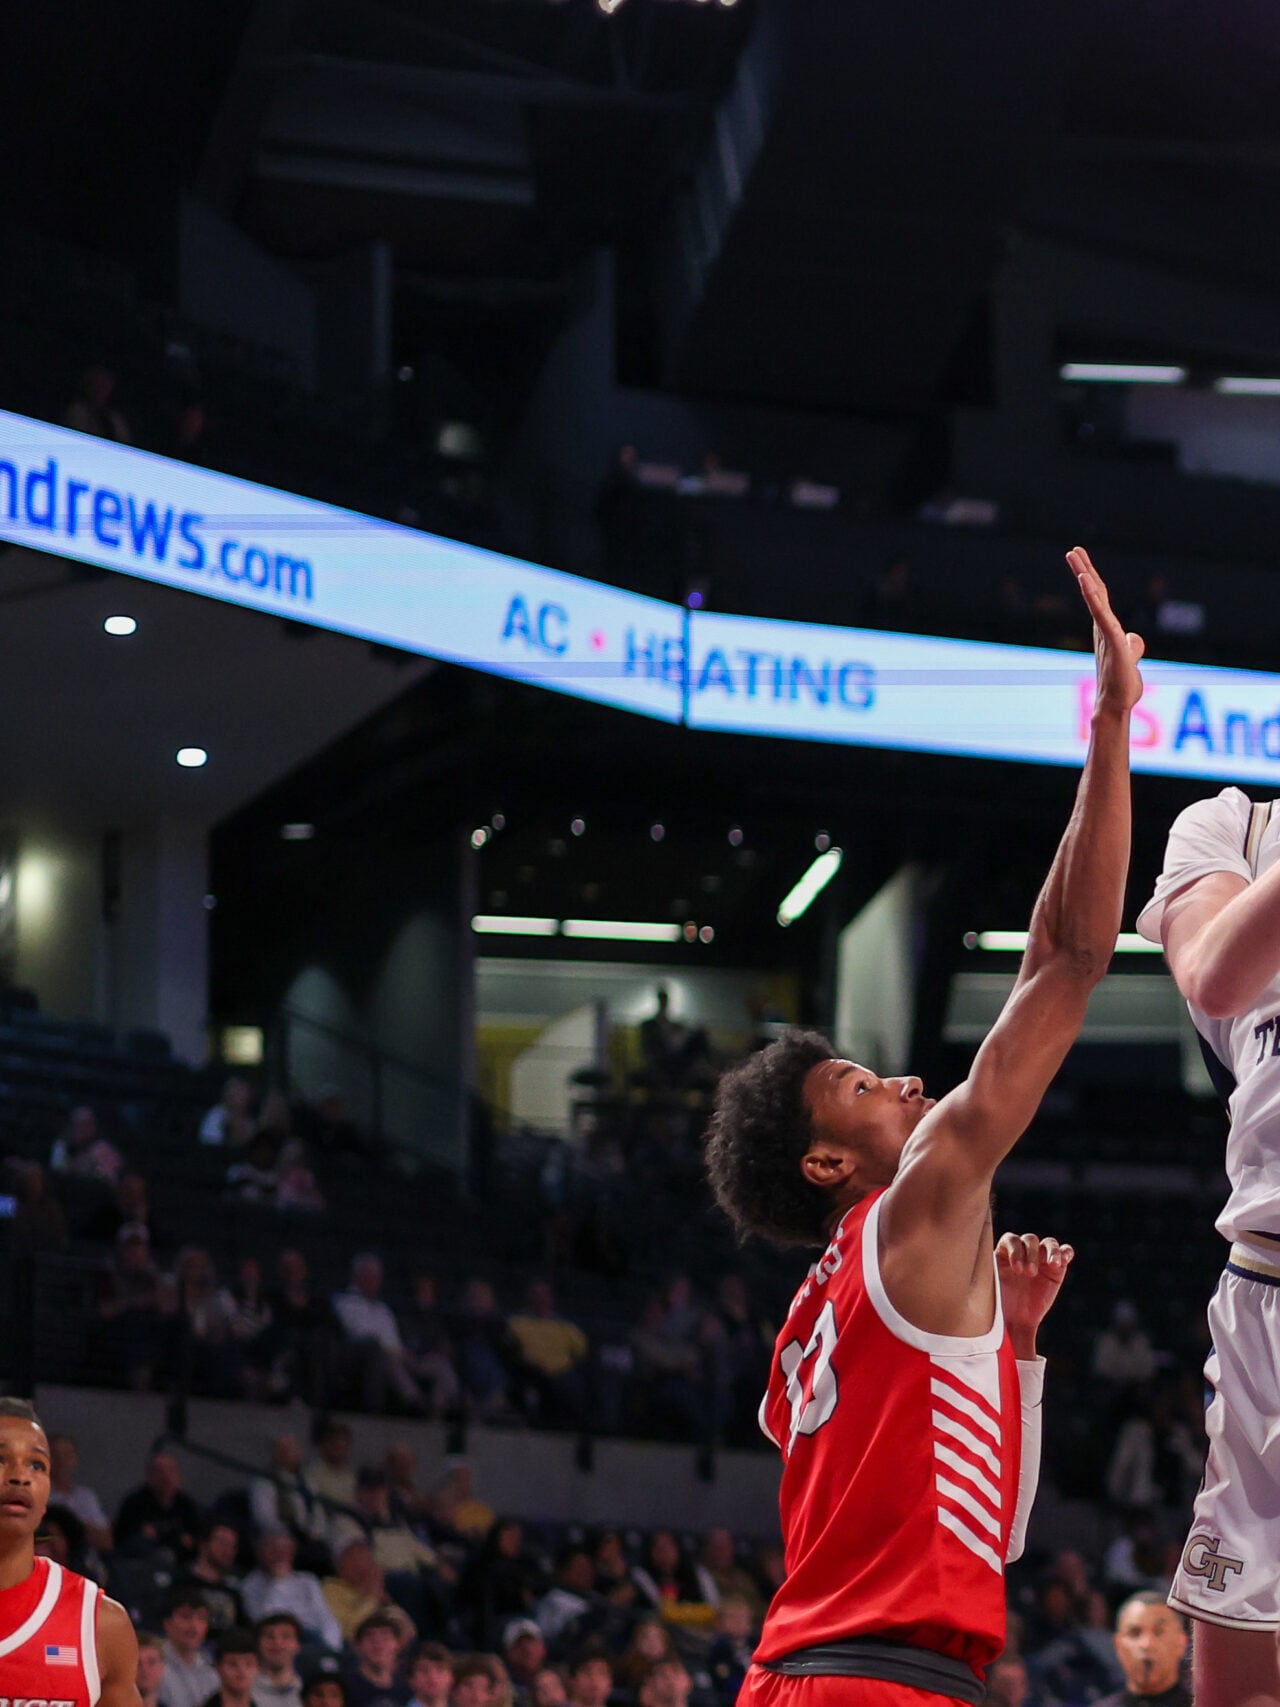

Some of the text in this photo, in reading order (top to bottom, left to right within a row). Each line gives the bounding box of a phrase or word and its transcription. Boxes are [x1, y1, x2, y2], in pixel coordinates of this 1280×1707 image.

[501, 592, 876, 712] AC HEATING
[1182, 1534, 1244, 1592] GT
